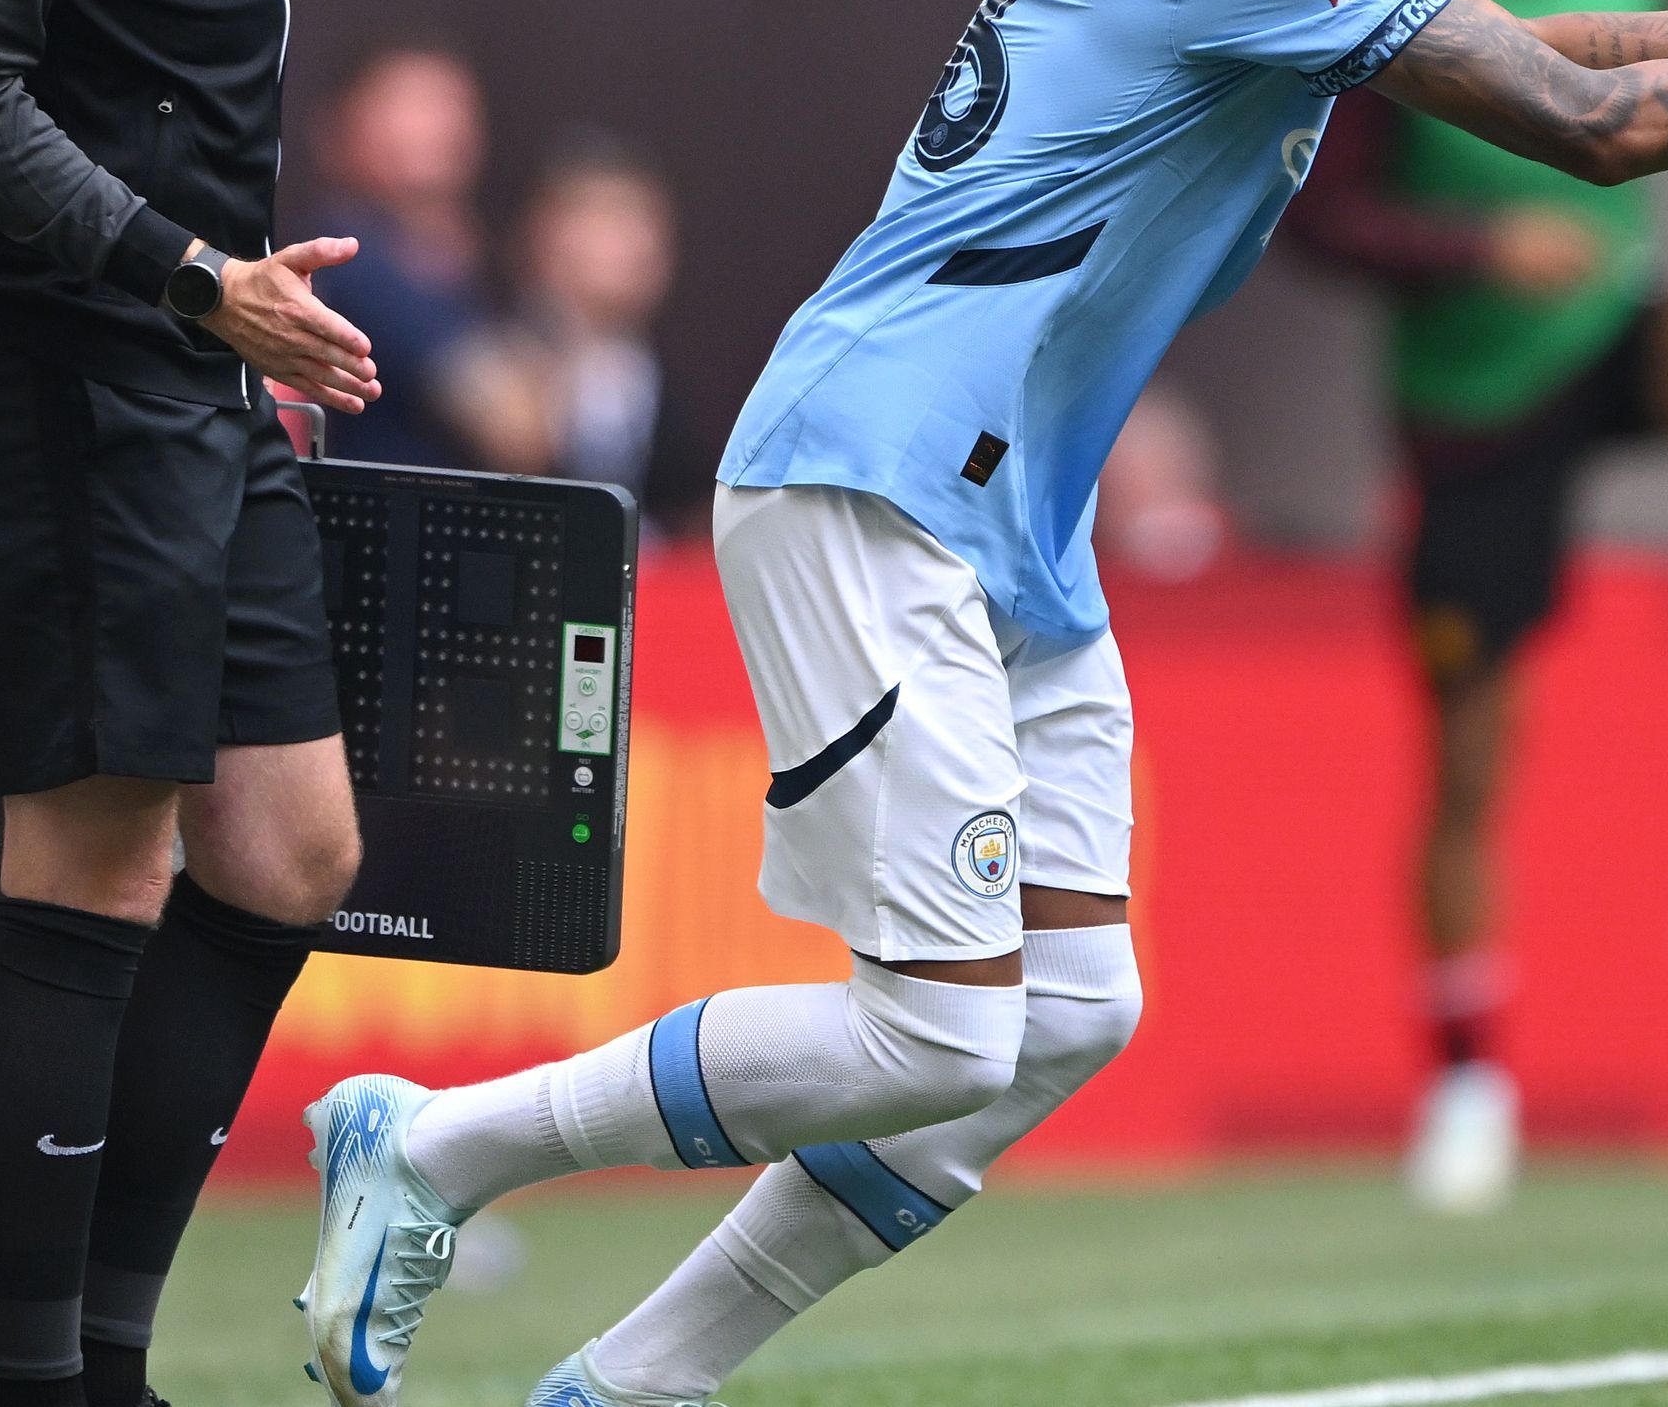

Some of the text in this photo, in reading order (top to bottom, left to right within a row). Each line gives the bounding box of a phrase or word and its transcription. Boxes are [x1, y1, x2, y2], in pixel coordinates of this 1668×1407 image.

[960, 817, 1013, 849] MANCHESTER
[985, 882, 1005, 894] CITY
[327, 910, 434, 939] OOTBALL
